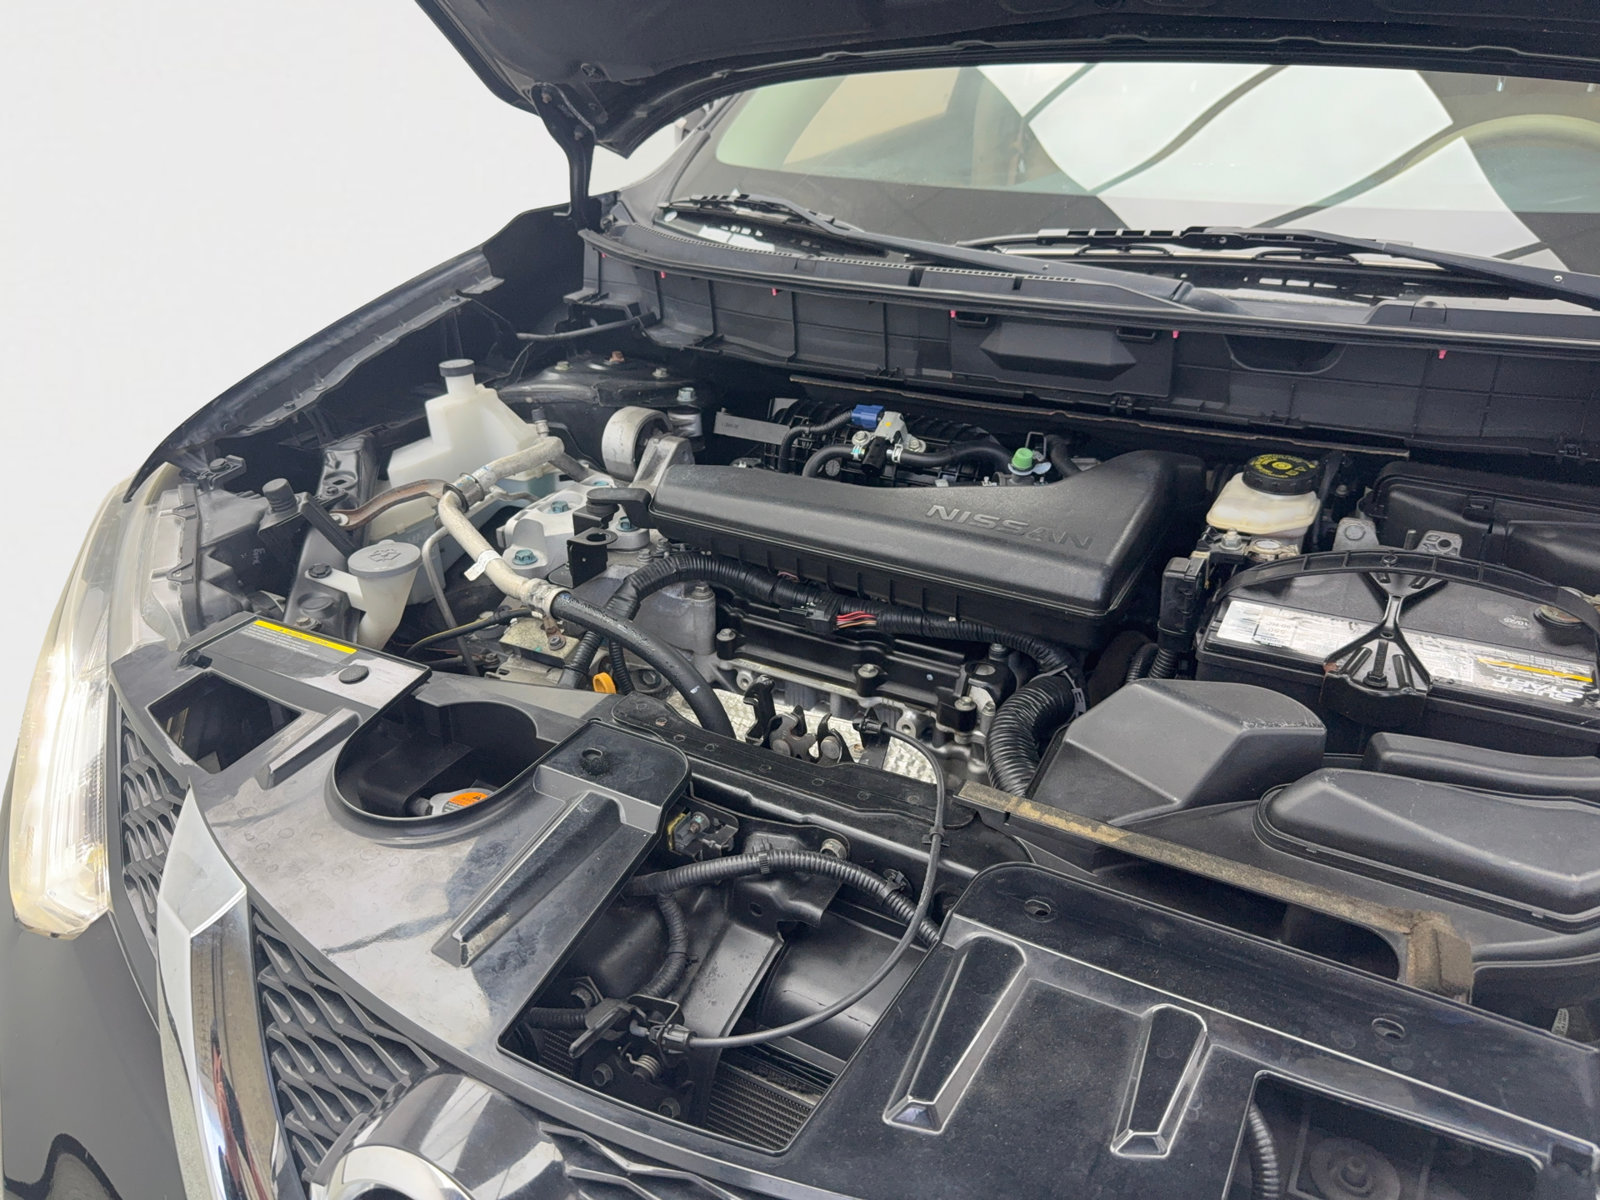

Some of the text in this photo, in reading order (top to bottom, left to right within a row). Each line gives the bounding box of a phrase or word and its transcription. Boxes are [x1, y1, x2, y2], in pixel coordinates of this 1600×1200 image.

[926, 504, 1094, 550] NISSAN
[1492, 678, 1575, 703] SUPER
[1497, 675, 1584, 699] START
